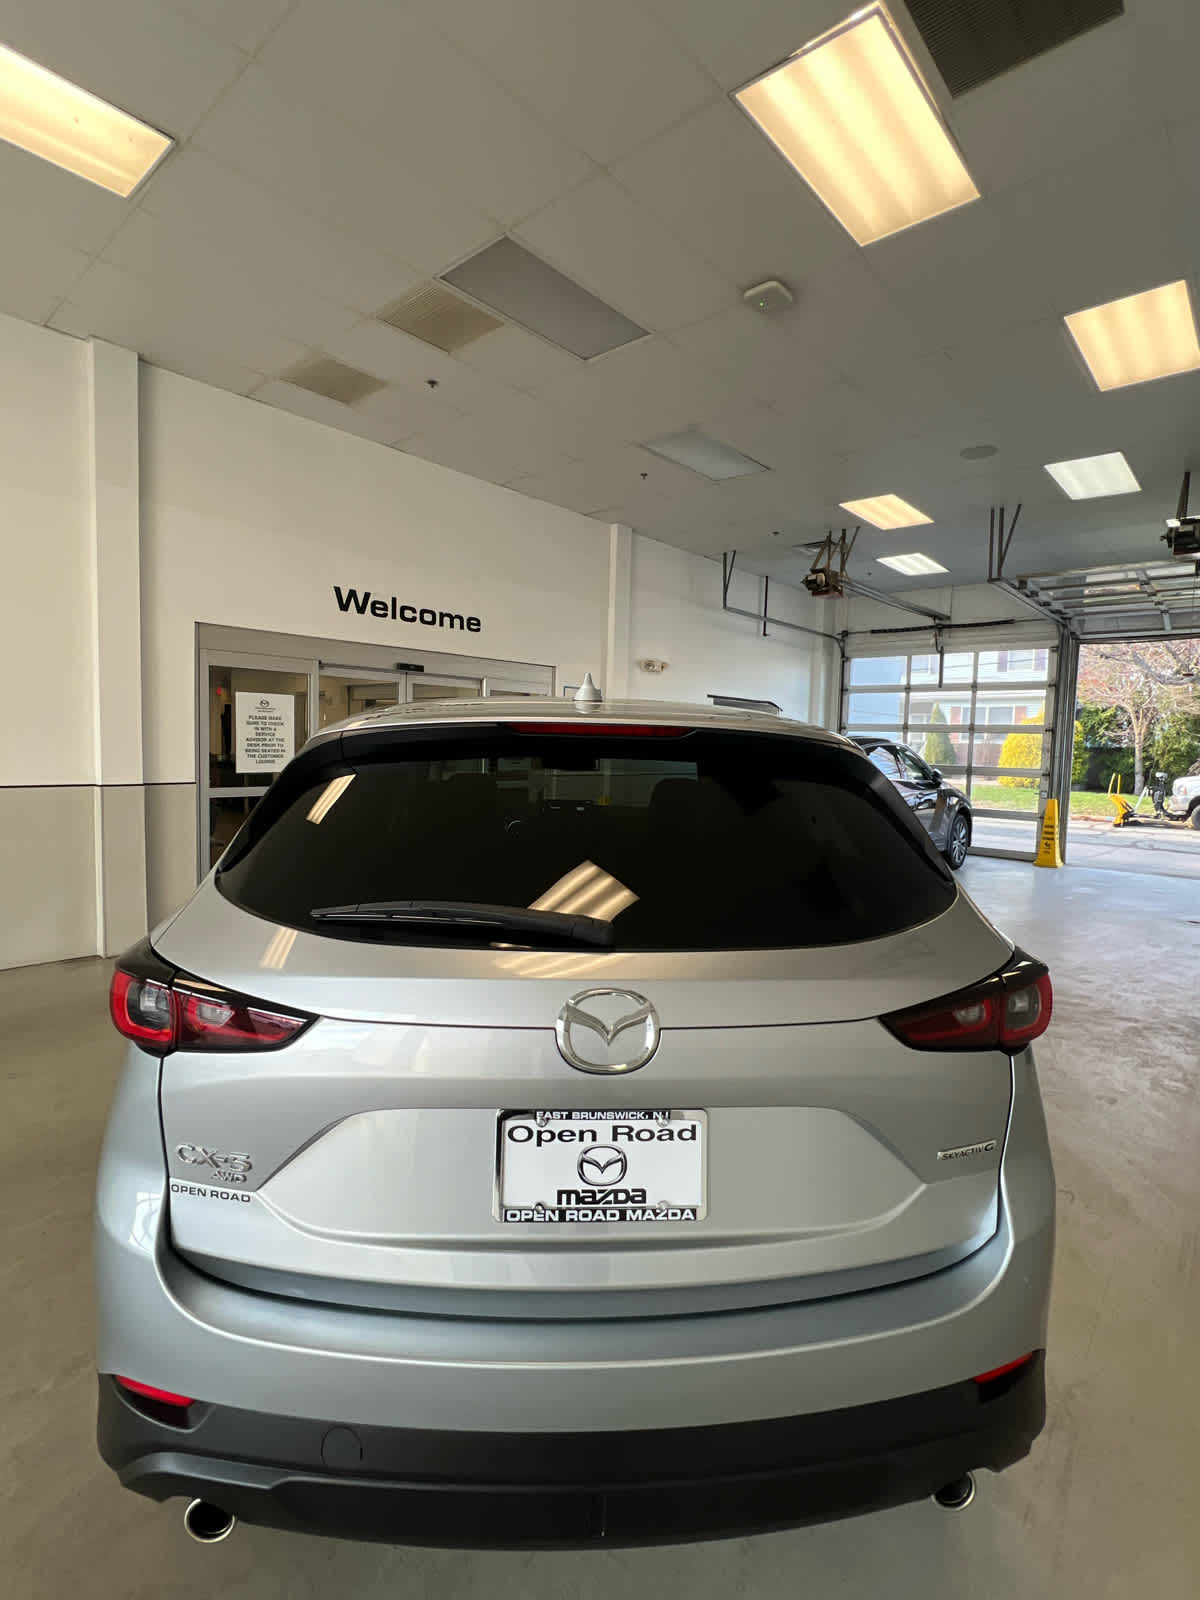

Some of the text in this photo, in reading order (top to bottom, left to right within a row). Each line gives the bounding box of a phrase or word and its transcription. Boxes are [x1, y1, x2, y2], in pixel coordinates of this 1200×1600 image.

[333, 585, 481, 632] Welcome
[536, 1111, 569, 1120] EAST
[507, 1124, 697, 1147] Open Road
[176, 1144, 252, 1172] CX-5
[211, 1170, 248, 1184] AWD
[171, 1184, 251, 1203] OPEN ROAD
[506, 1208, 695, 1222] OPEN ROAD MAZDA
